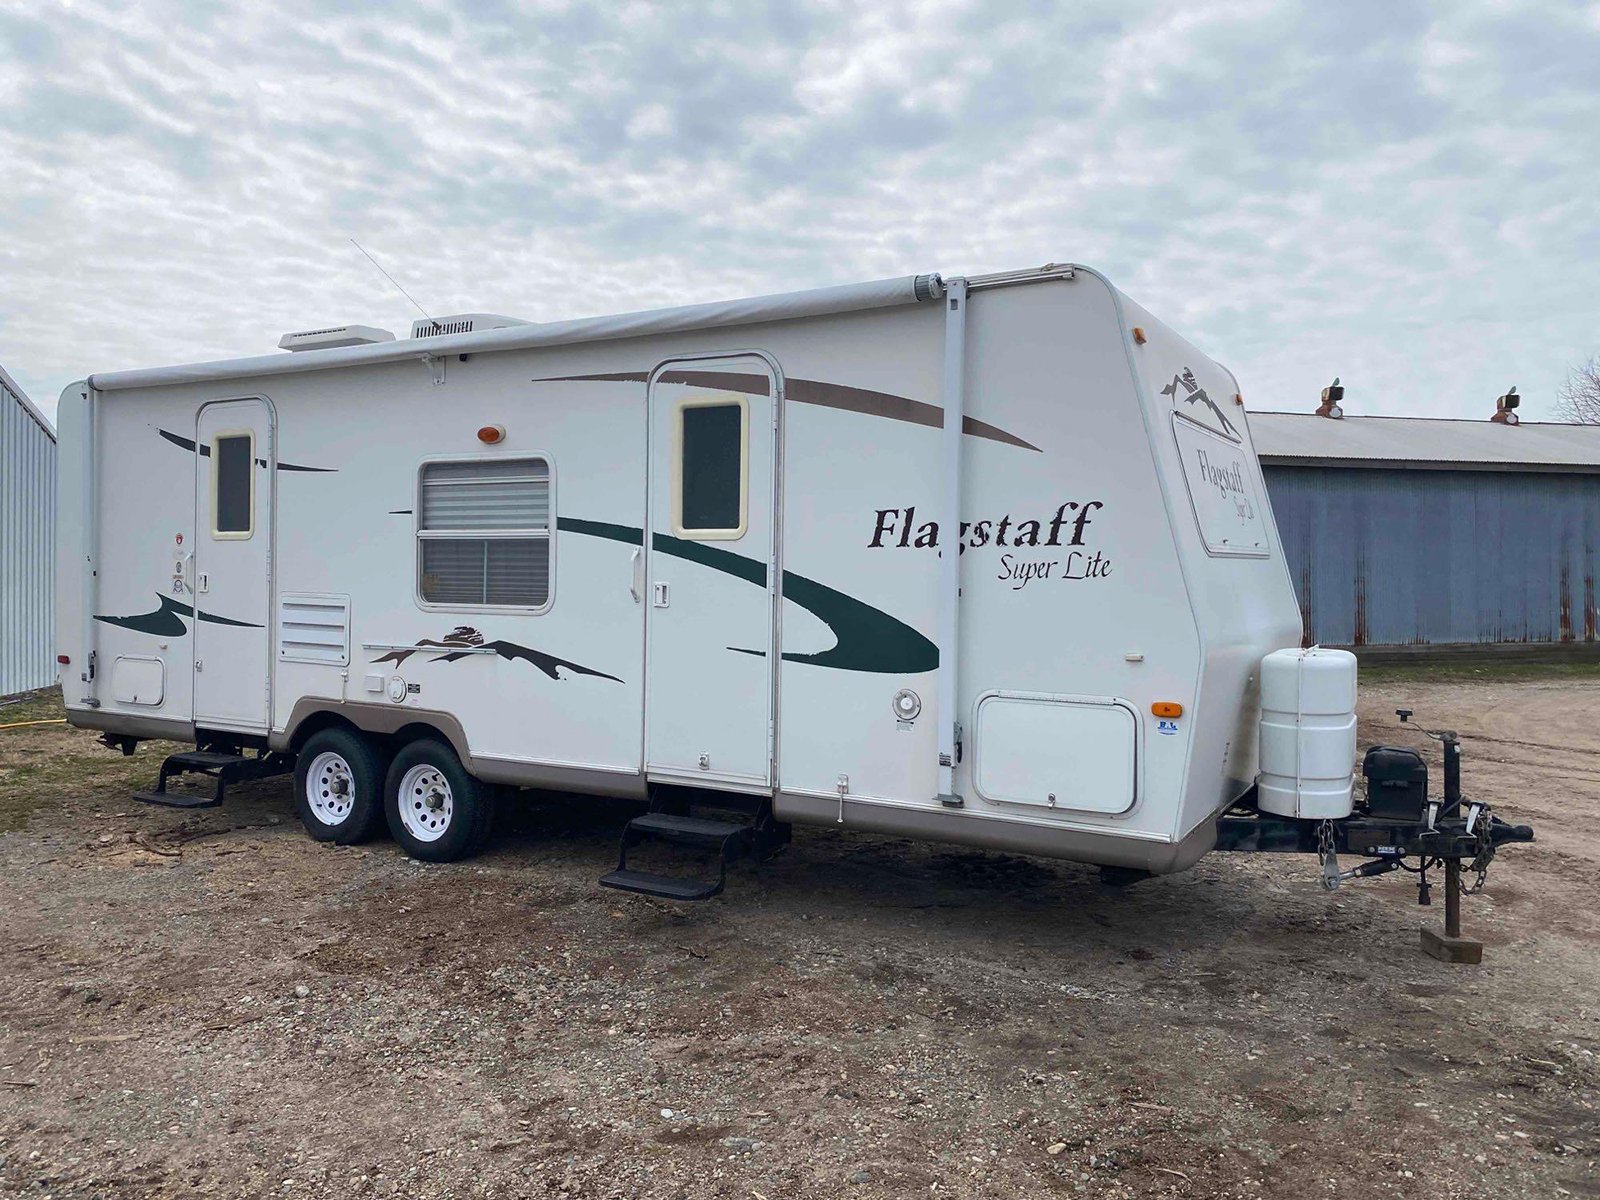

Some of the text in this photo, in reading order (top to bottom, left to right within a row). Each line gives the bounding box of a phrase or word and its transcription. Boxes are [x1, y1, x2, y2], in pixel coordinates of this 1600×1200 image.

[1197, 449, 1245, 499] Flagstaff
[997, 550, 1113, 590] Super Lite
